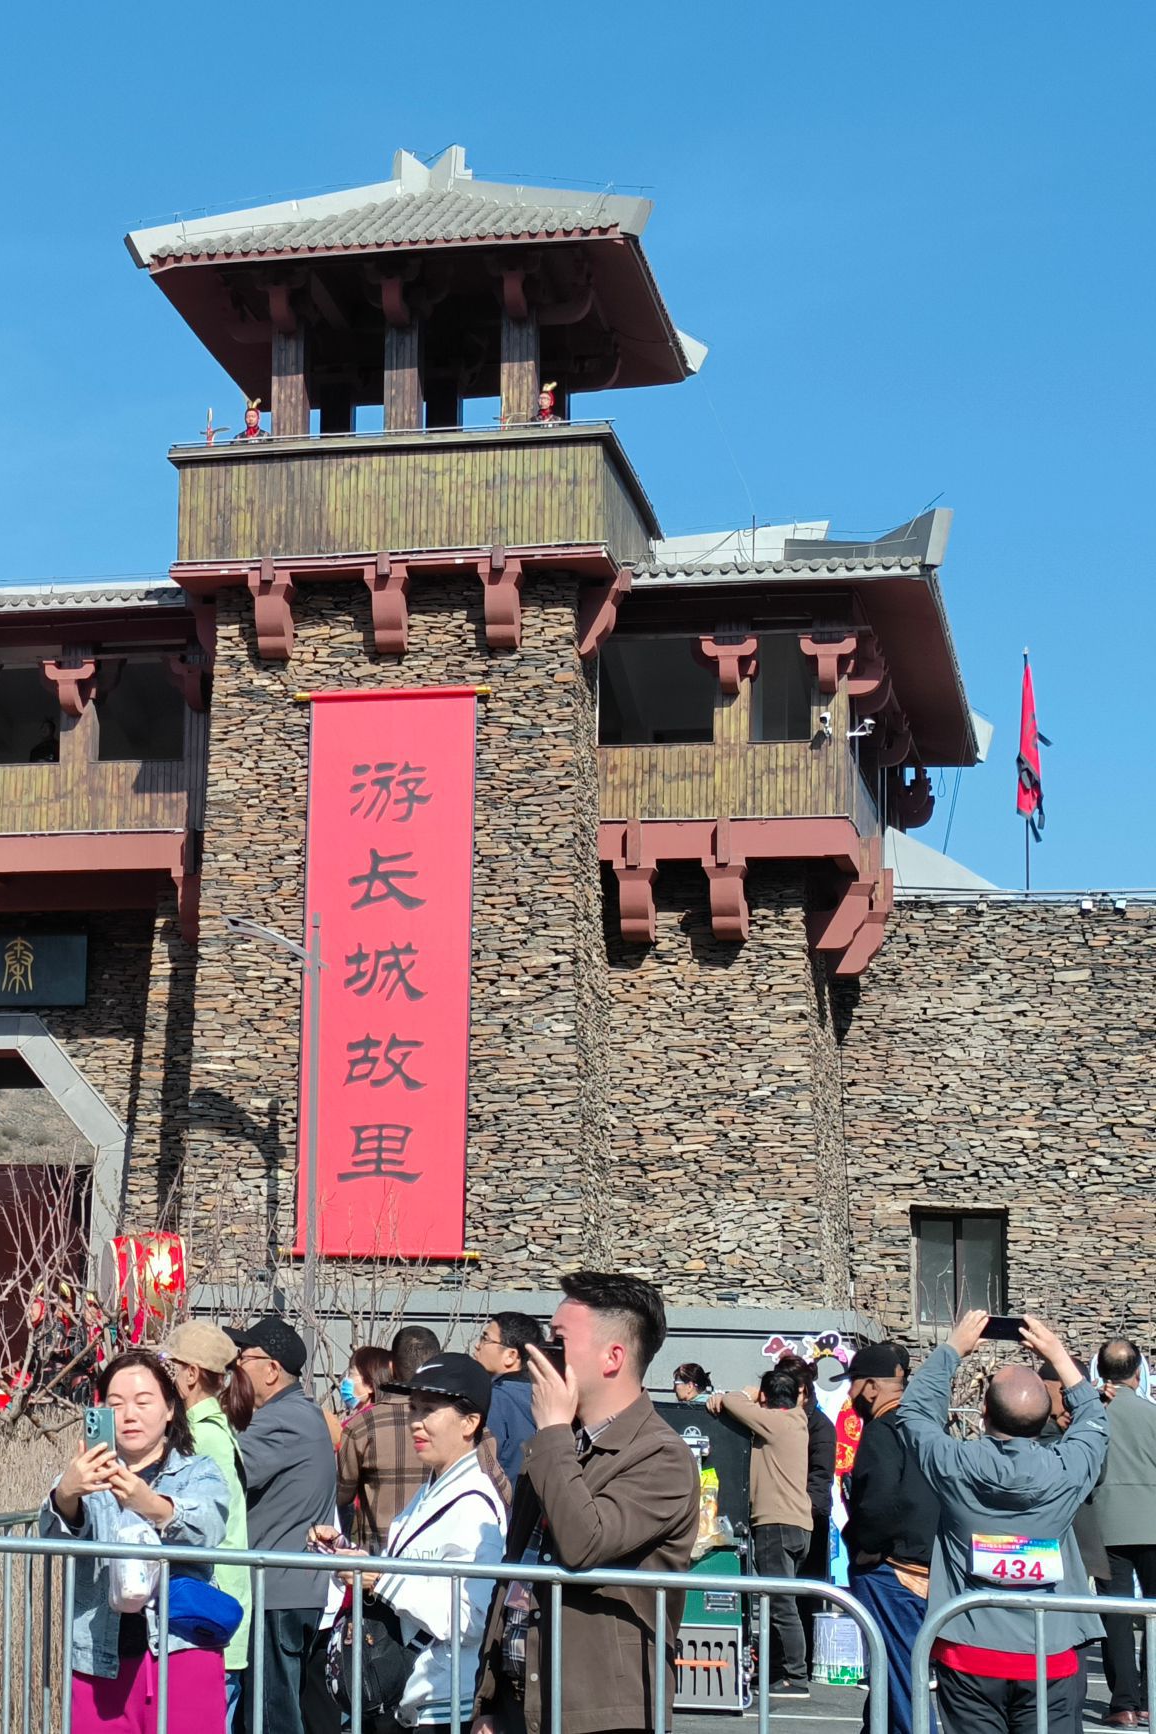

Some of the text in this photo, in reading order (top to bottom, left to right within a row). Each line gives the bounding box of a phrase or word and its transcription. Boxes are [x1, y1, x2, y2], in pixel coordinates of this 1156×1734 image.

[337, 761, 433, 1184] 游长城故里
[992, 1559, 1045, 1581] 434
